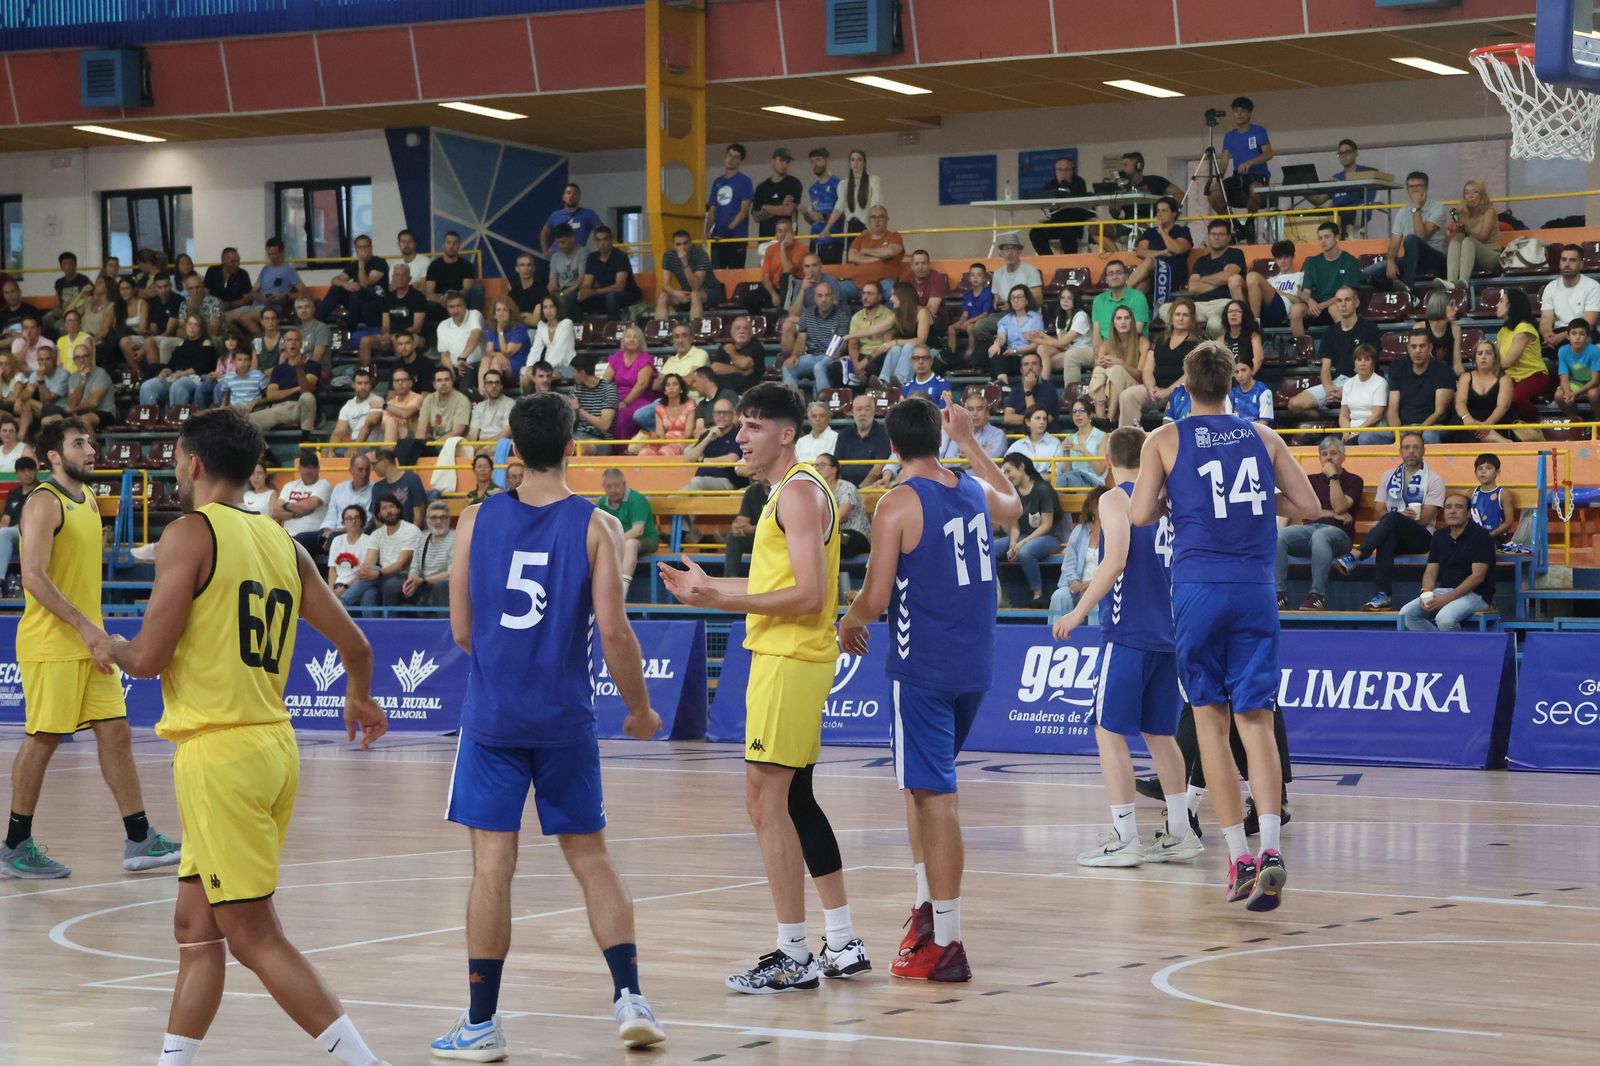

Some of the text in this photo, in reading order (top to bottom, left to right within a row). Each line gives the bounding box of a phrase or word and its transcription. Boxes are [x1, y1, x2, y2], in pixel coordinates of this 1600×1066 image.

[1268, 261, 1275, 271] 7
[1211, 428, 1255, 442] ZAMORA
[1197, 456, 1267, 519] 14
[943, 512, 993, 587] 11
[500, 551, 549, 630] 5
[239, 580, 293, 674] 60
[1277, 668, 1471, 714] LIMERKA
[284, 695, 312, 708] CAJA
[400, 697, 442, 710] RURAL
[302, 708, 339, 718] ZAMORA
[389, 710, 427, 719] ZAMORA
[1008, 709, 1065, 723] Ganaderos
[1067, 711, 1081, 723] de
[821, 721, 843, 729] CIÓN
[1034, 725, 1089, 736] DESDE 1966
